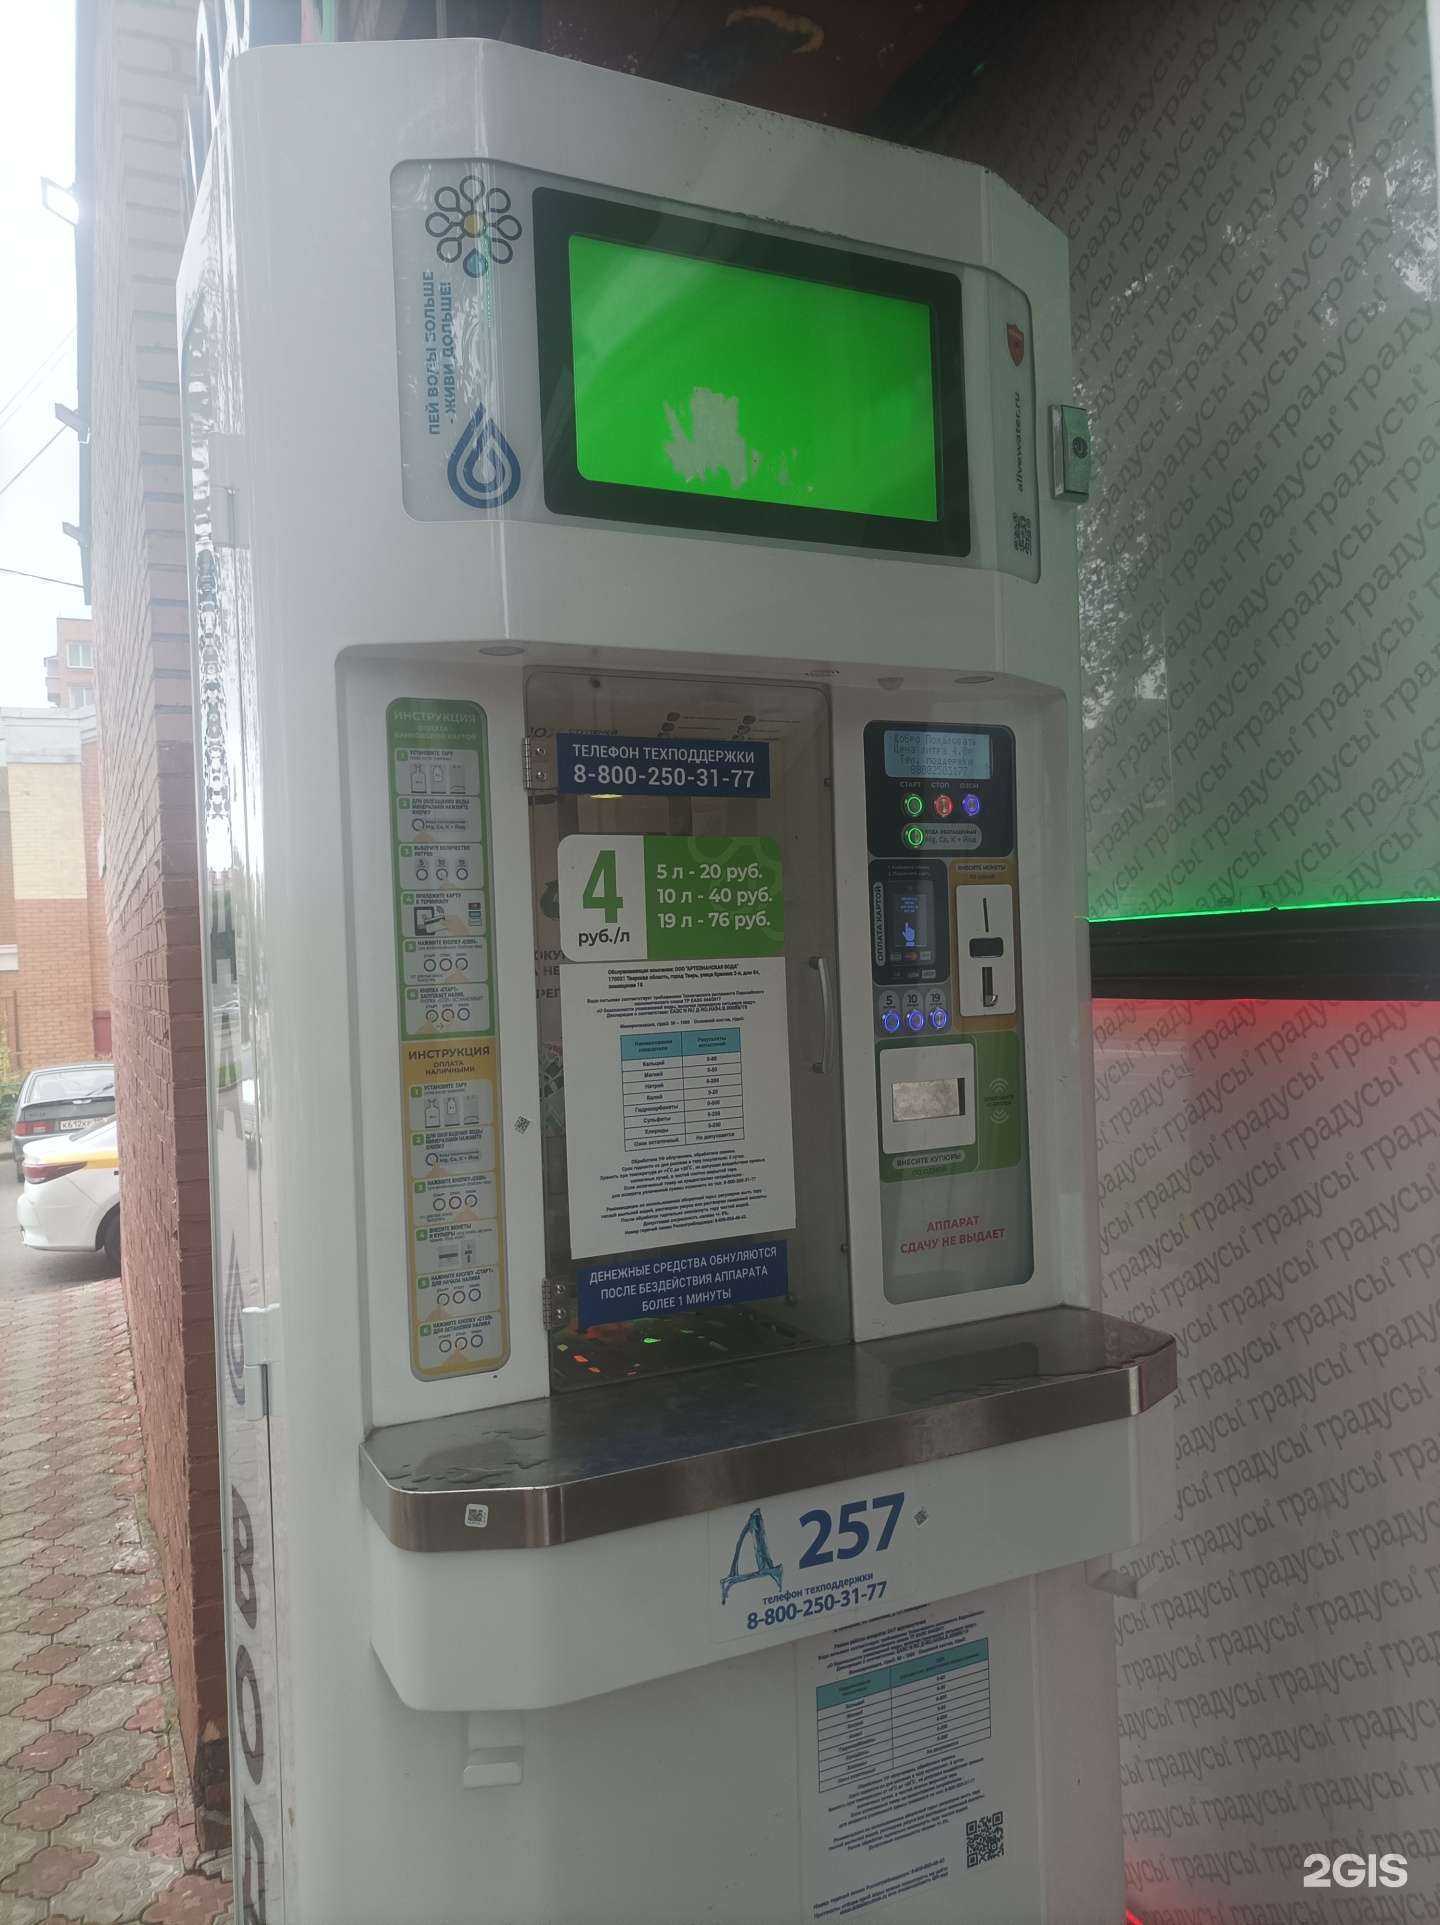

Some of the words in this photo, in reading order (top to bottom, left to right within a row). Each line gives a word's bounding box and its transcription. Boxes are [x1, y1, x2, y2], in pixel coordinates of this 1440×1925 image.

[443, 363, 456, 414] ЖИВИ
[425, 401, 440, 435] ПЕЙ
[572, 744, 639, 760] ТЕЛЕФОН
[642, 747, 755, 764] ТЕХПОДДЕРЖКИ
[573, 764, 755, 788] 8-800-250-31-77
[657, 865, 667, 880] 5
[672, 866, 683, 880] л
[700, 864, 721, 879] 20
[727, 863, 763, 882] руб.
[582, 850, 624, 924] 4
[657, 889, 676, 904] 10
[680, 890, 692, 904] л
[708, 888, 732, 903] 40
[736, 886, 773, 906] руб.
[657, 913, 677, 928] 19
[680, 914, 692, 928] л
[708, 912, 731, 927] 76
[734, 911, 772, 930] руб.
[578, 926, 631, 947] руб./л
[907, 994, 918, 1003] 10
[408, 1046, 491, 1060] ИНСТРУКЦИЯ
[425, 1066, 476, 1077] НАЛИЧНЫМИ
[433, 1060, 465, 1069] ОПЛАТА
[896, 1157, 929, 1167] ВНЕСИТЕ
[926, 1215, 981, 1233] АППАРАТ
[900, 1239, 941, 1255] СДАЧУ
[942, 1234, 958, 1248] НЕ
[959, 1227, 1007, 1246] ВЫДАЕТ
[588, 1263, 651, 1287] ДЕНЕЖНЫЕ
[653, 1256, 707, 1274] СРЕДСТВА
[709, 1246, 778, 1266] ОБНУЛЯЮТСЯ
[601, 1285, 637, 1301] ПОСЛЕ
[639, 1273, 712, 1296] БЕЗДЕЙСТВИЯ
[714, 1265, 769, 1281] АППАРАТА
[642, 1297, 675, 1312] БОЛЕЕ
[679, 1294, 684, 1306] 1
[687, 1288, 733, 1305] МИНУТЫ
[799, 1491, 905, 1570] 257
[762, 1588, 803, 1606] телефон
[805, 1572, 874, 1597] техподдержки
[746, 1580, 888, 1631] 8-800-250-31-77
